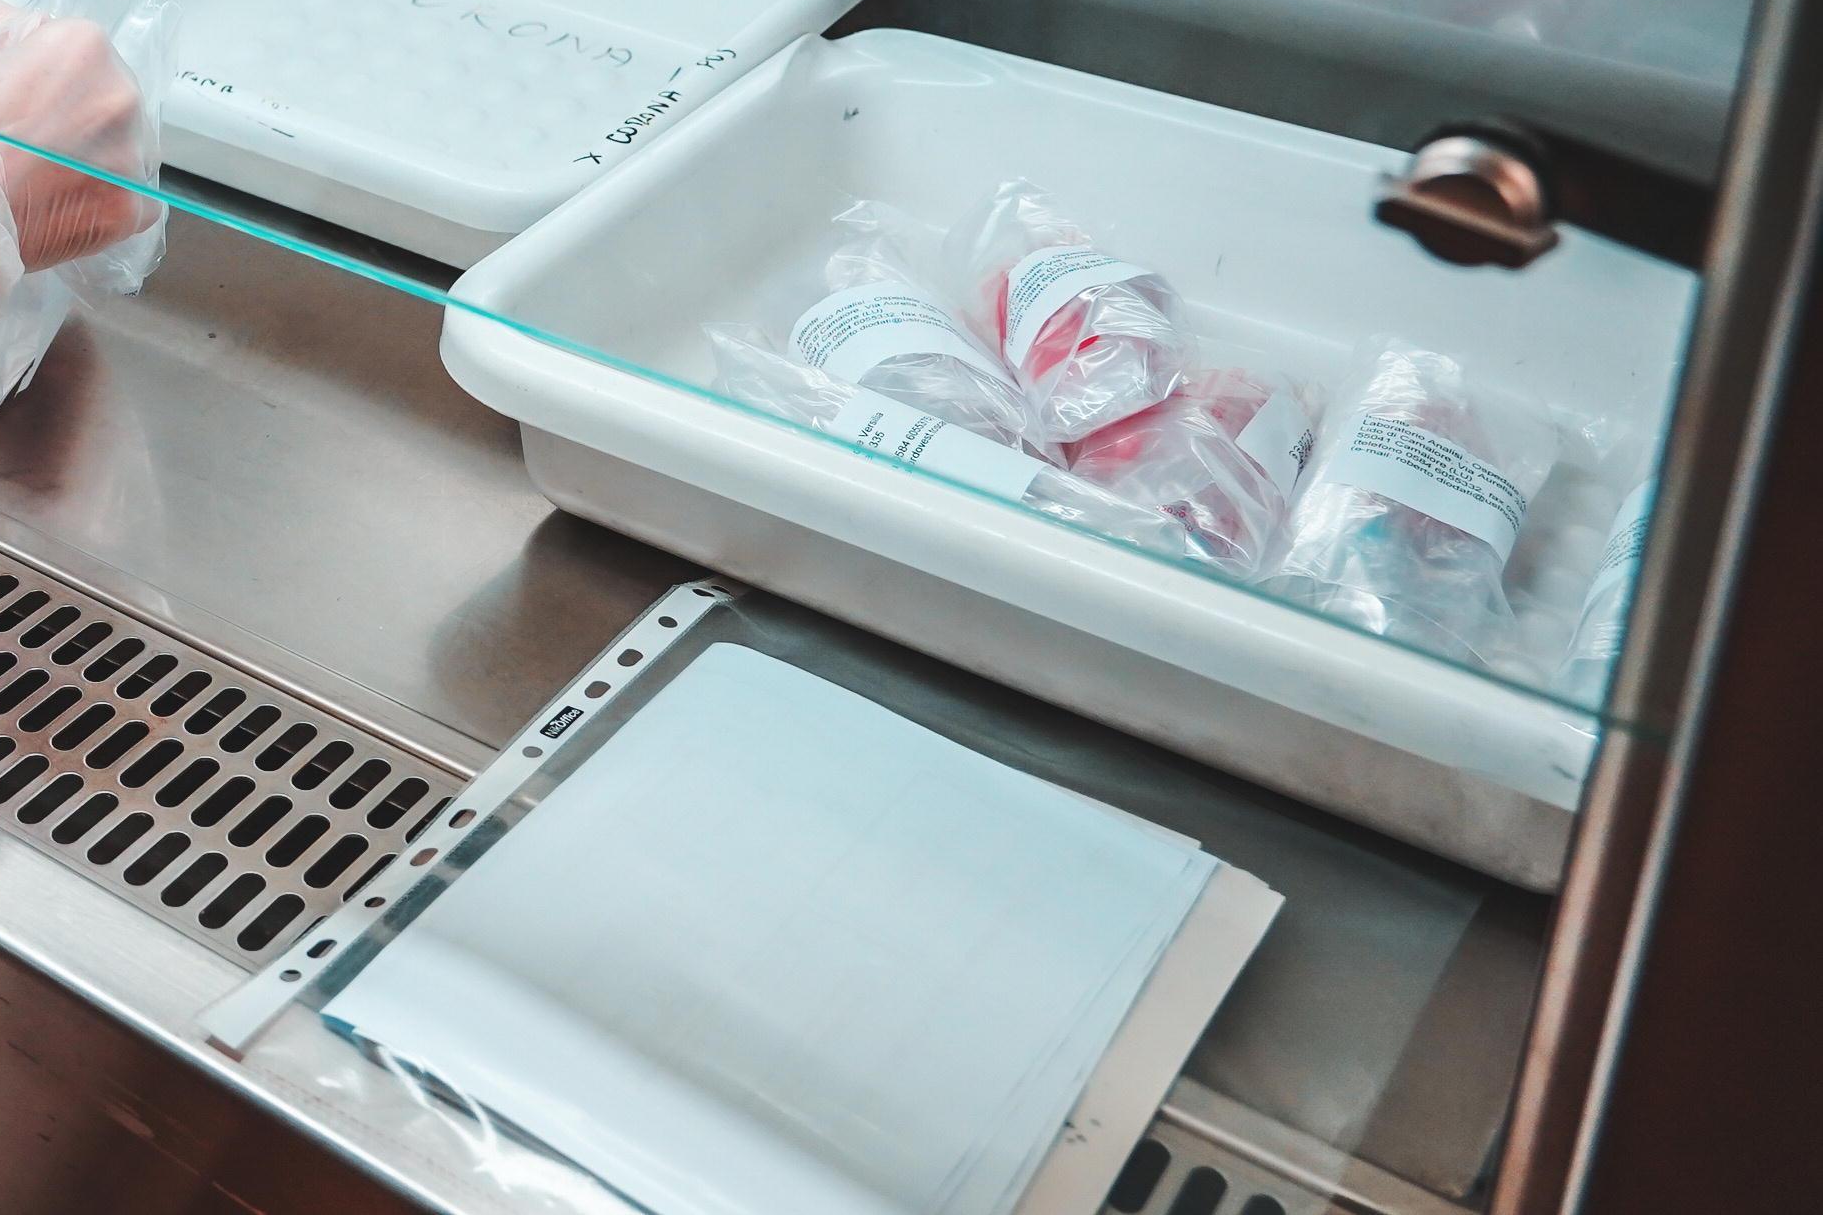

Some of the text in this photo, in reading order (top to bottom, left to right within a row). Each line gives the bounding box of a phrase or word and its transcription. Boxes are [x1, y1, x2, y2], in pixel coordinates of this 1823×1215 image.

[868, 430, 885, 449] 335
[1356, 431, 1473, 482] 55041 Camaiore (LU)
[1359, 426, 1384, 435] Lido
[1458, 462, 1475, 475] Via
[1477, 473, 1513, 497] Aurelia
[1362, 419, 1426, 441] Laboratorio
[1427, 439, 1464, 461] Analisi
